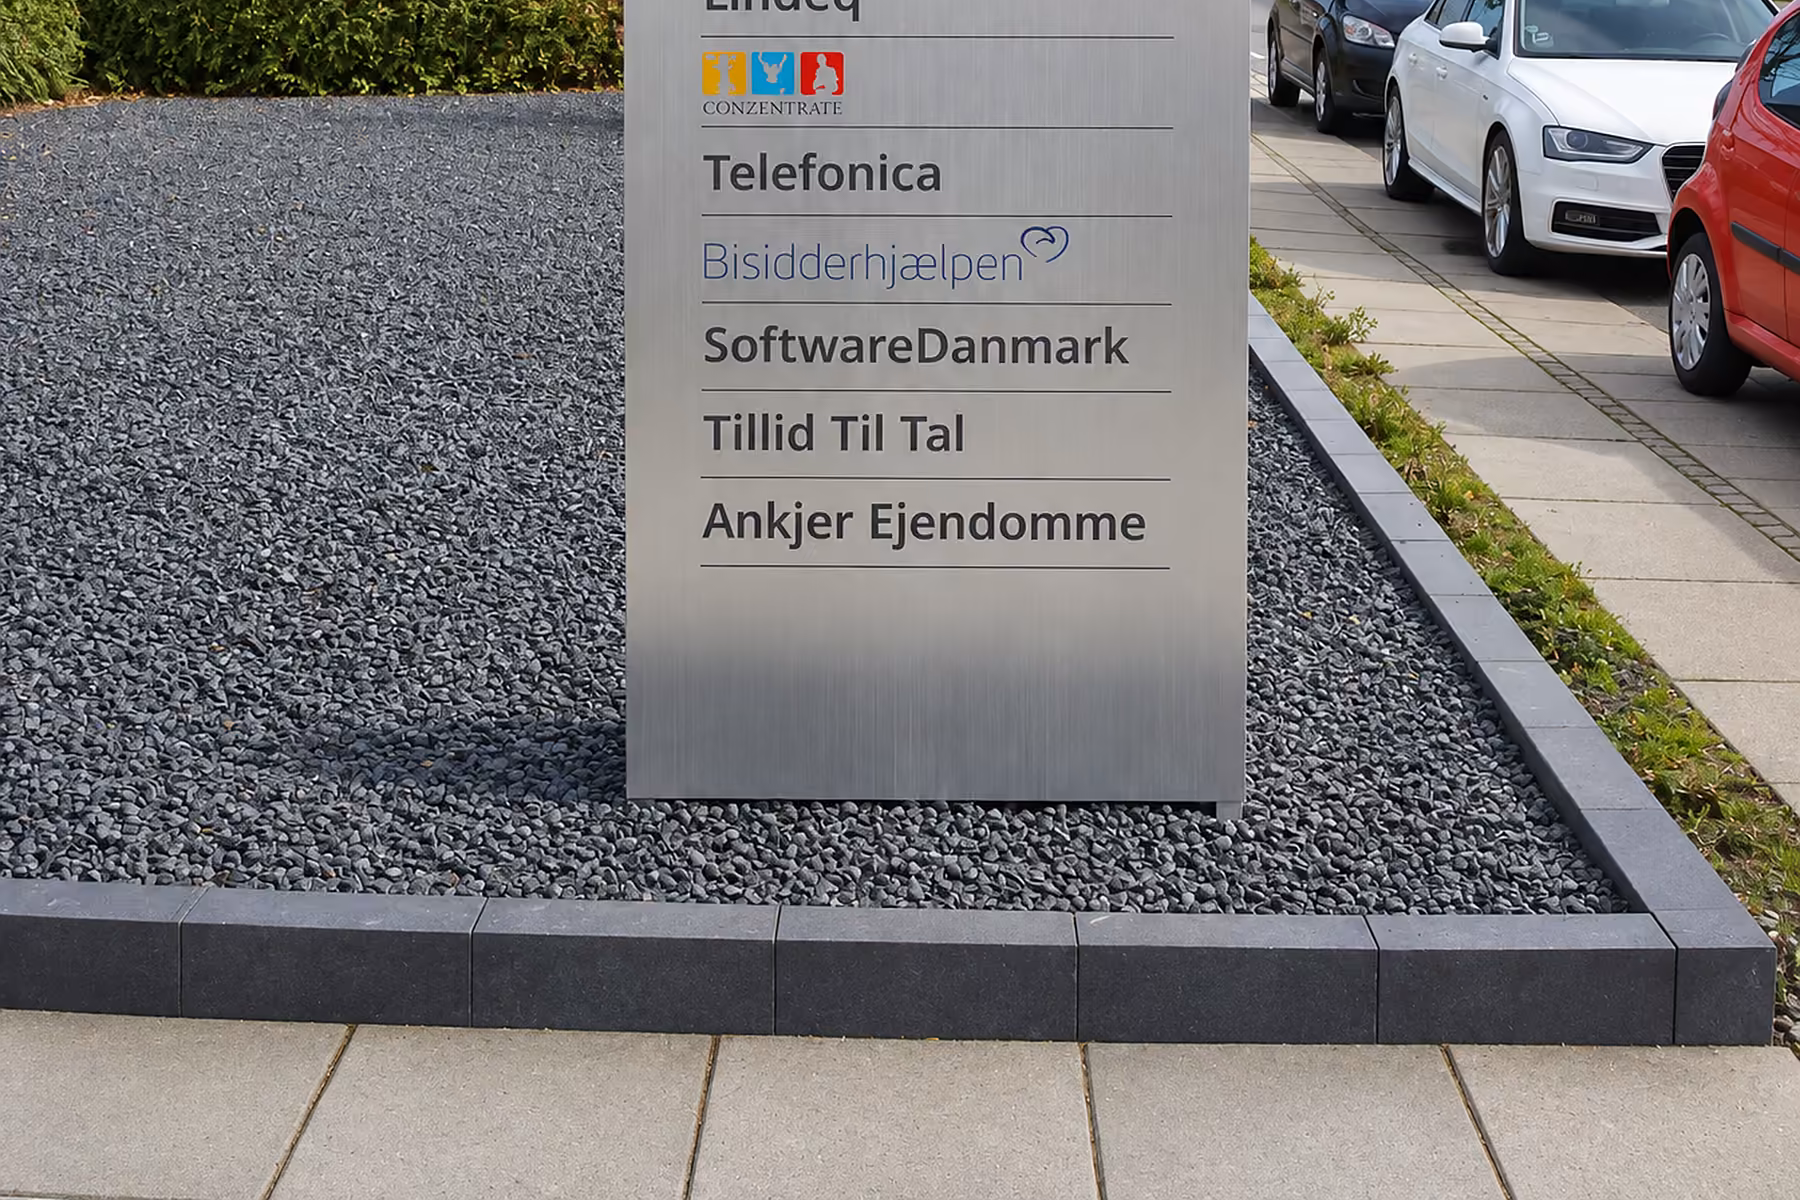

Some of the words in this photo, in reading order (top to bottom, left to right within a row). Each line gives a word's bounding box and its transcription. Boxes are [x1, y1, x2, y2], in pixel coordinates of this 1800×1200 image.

[702, 100, 843, 116] CONZENTRATE
[703, 152, 941, 192] Telefonica
[702, 241, 1023, 290] Bisidderhjælpen
[704, 325, 1130, 365] SoftwareDanmark
[703, 412, 815, 452] Tillid
[830, 413, 884, 452] Til
[899, 413, 964, 452] Tal
[702, 500, 854, 550] Ankjer
[870, 501, 1147, 551] Ejendomme
